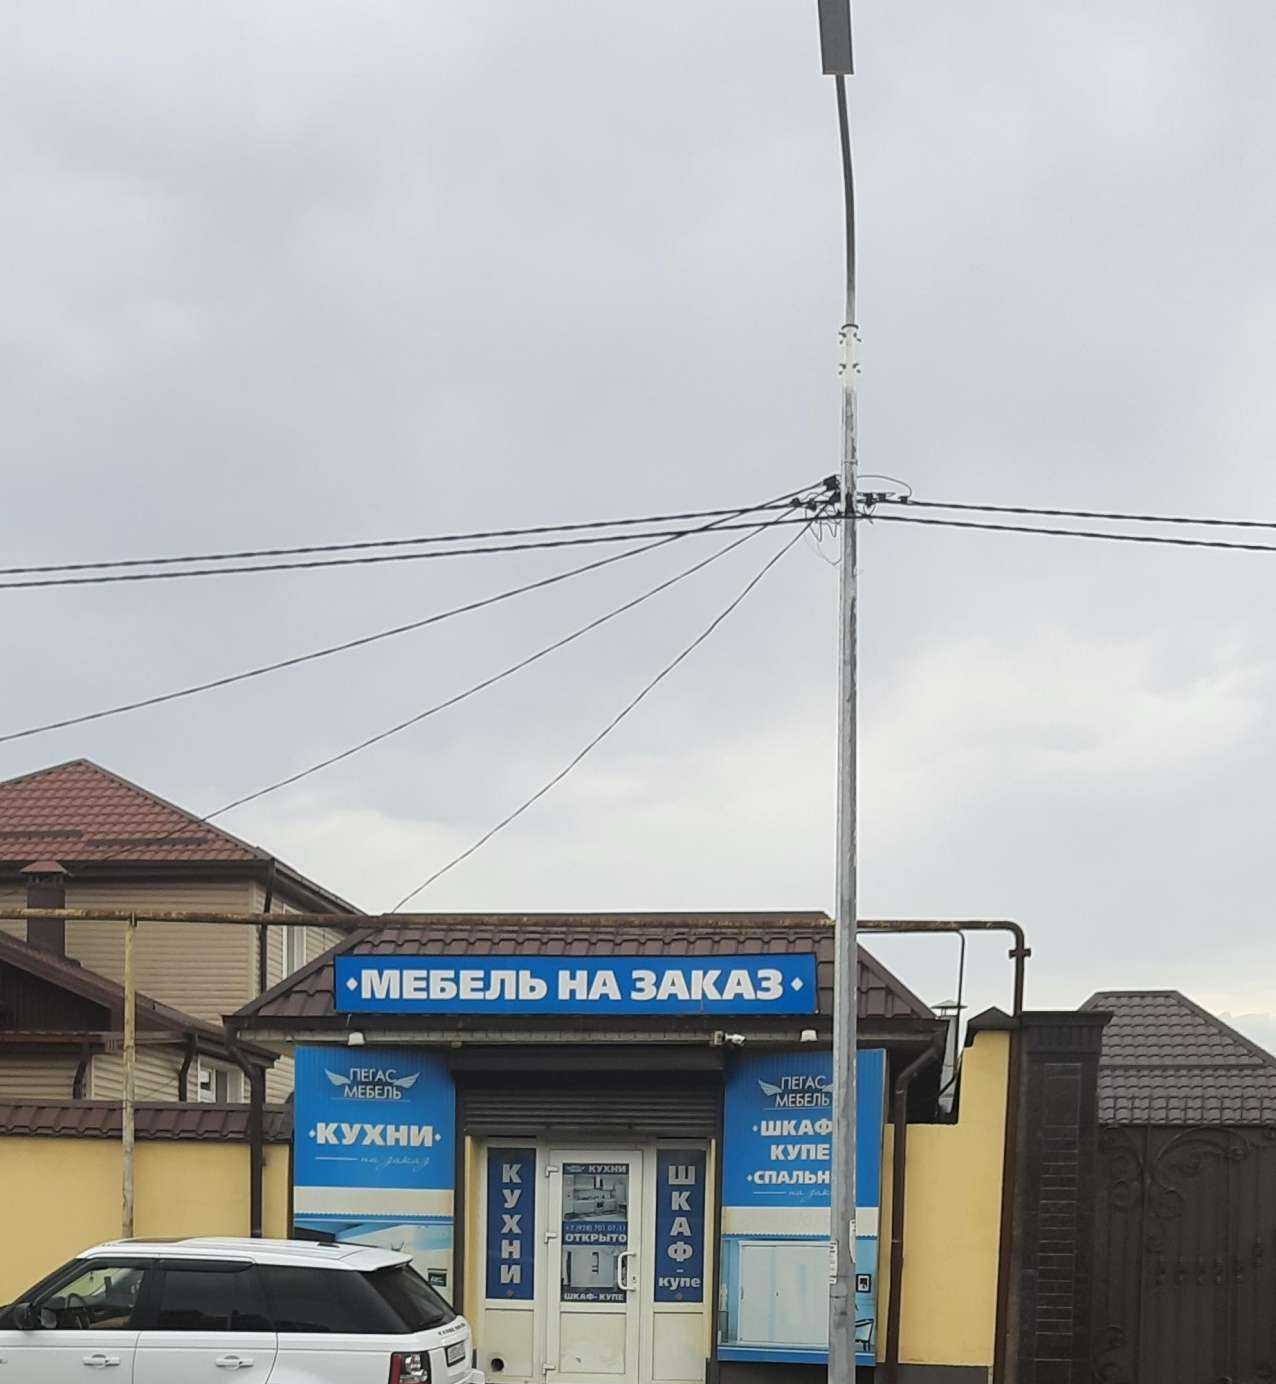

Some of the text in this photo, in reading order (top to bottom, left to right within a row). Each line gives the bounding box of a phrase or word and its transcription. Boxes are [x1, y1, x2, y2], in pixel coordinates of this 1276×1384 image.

[361, 969, 784, 1001] МЕБЕЛЬ НА ЗАКАЗ
[350, 1067, 397, 1083] ПЕГАС
[781, 1075, 827, 1090] ПЕГАС
[344, 1085, 402, 1100] МЕБЕЛЬ
[775, 1092, 830, 1107] МЕБЕЛЬ
[316, 1122, 433, 1147] КУХНИ
[760, 1118, 833, 1136] ШКАФ
[770, 1144, 830, 1161] КУПЕ
[588, 1165, 627, 1174] КУХНИ
[753, 1170, 832, 1185] СПАЛЬН
[501, 1163, 523, 1285] КУХНИ
[565, 1233, 627, 1243] ОТКРЫТО
[658, 1276, 701, 1290] купе
